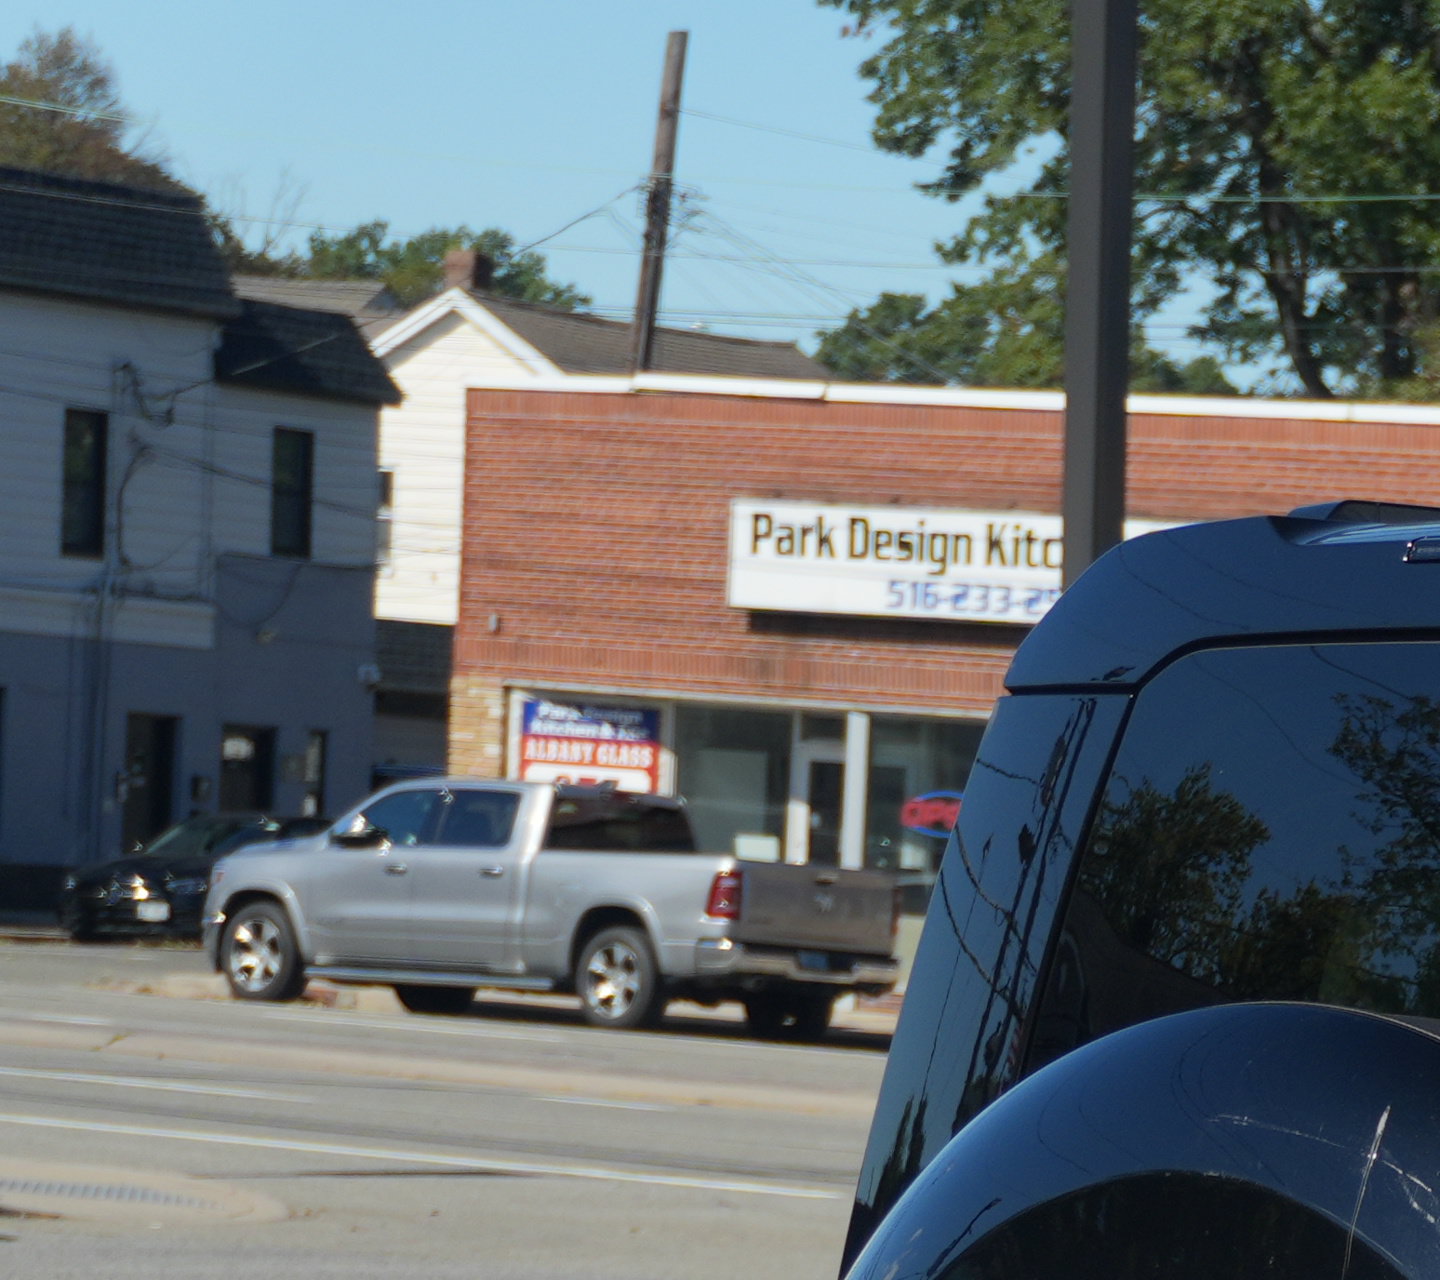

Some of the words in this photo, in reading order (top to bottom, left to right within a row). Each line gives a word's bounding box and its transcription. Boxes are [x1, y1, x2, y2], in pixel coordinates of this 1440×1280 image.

[751, 513, 836, 559] Park
[848, 517, 971, 576] Design
[597, 744, 653, 768] GLASS
